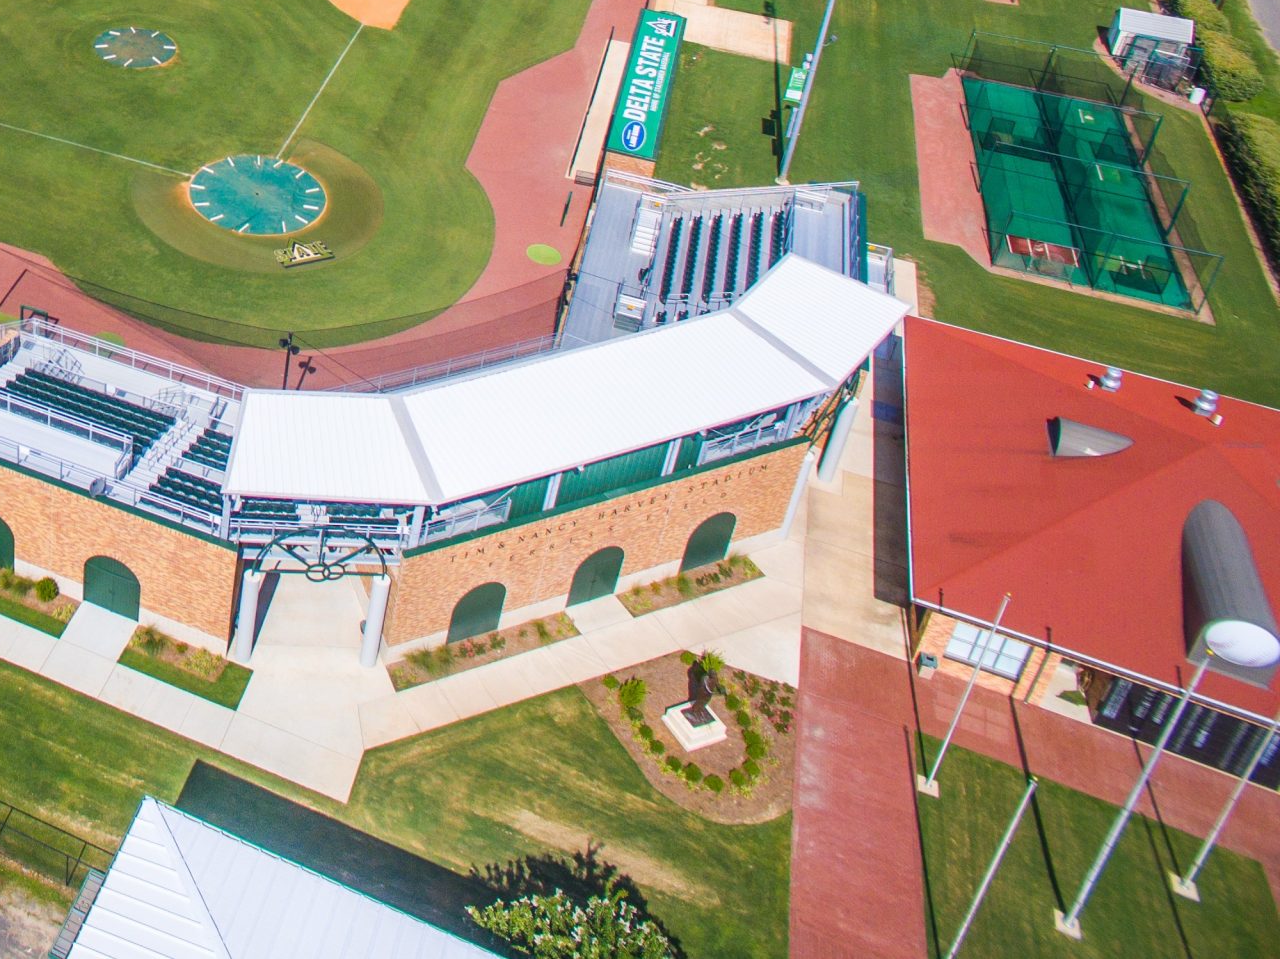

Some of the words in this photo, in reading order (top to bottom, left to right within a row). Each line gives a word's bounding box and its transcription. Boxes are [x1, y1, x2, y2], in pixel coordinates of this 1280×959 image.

[635, 35, 665, 78] STATE
[623, 79, 654, 122] DELTA
[451, 547, 485, 562] TIM
[519, 520, 577, 543] NANCY
[598, 494, 668, 520] HARVEY
[688, 465, 768, 493] STADIUM
[646, 492, 726, 521] FIELD
